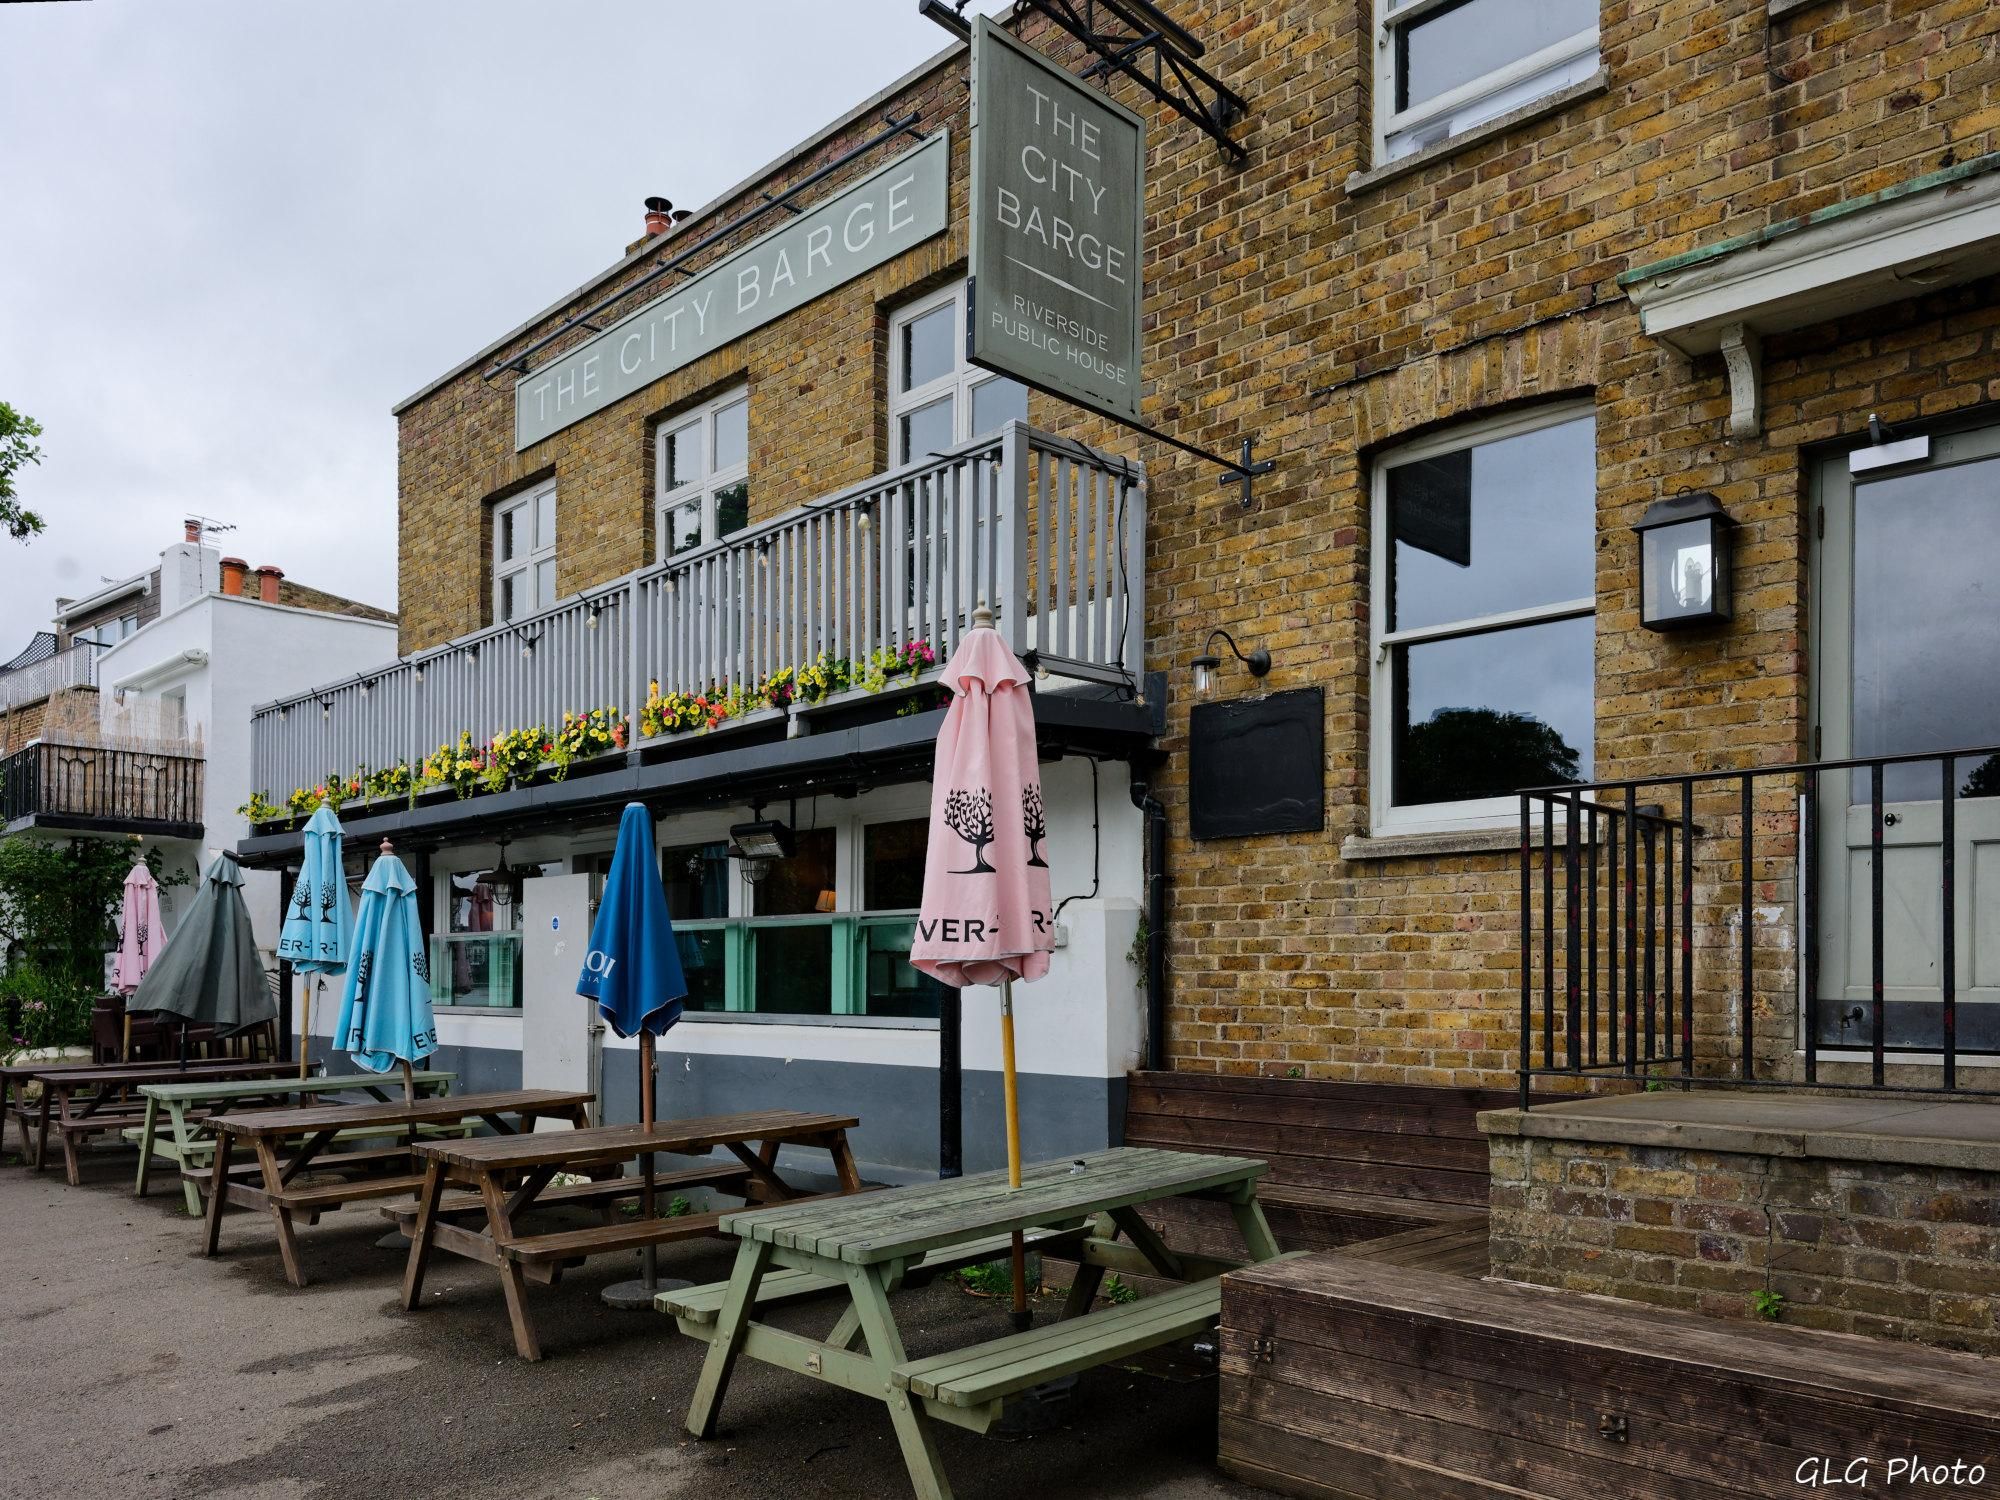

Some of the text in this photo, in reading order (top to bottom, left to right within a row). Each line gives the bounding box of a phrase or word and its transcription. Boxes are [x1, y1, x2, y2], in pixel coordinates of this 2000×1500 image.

[1026, 83, 1101, 162] THE
[1021, 145, 1107, 216] CITY
[996, 186, 1126, 286] BARGE
[533, 173, 915, 422] THE CITY BARGE
[1013, 294, 1109, 352] RIVERSIDE
[991, 312, 1127, 385] PUBLIC HOUSE
[280, 938, 312, 952] ER-
[915, 917, 999, 943] VER-
